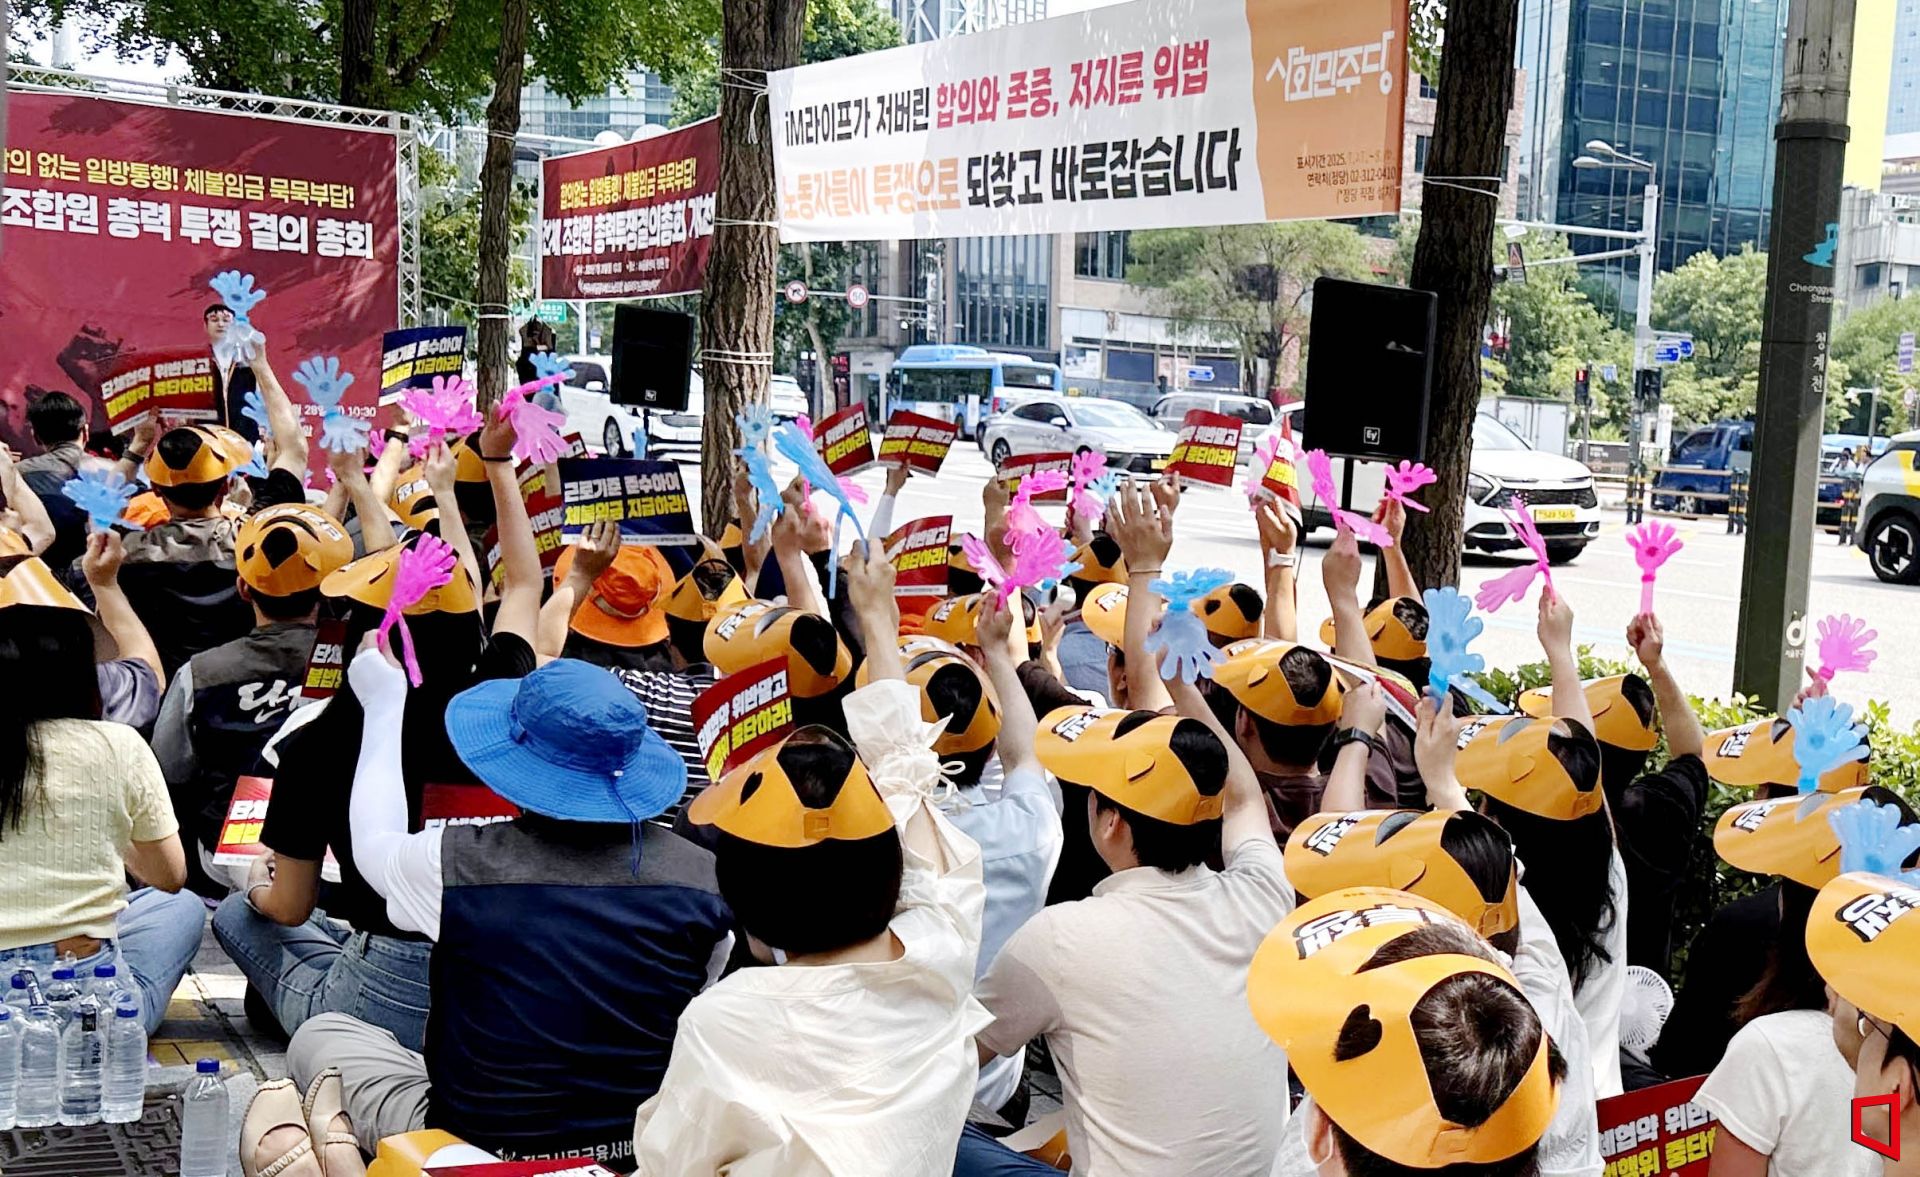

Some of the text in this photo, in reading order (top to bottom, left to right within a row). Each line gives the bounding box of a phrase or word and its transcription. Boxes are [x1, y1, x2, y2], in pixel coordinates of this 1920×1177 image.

[784, 39, 1210, 147] iM라이프가 저버린 합의와 존중, 저지른 위법
[37, 151, 81, 182] 없는
[85, 158, 179, 190] 일방통행!
[184, 168, 264, 200] 체불임금
[269, 178, 355, 209] 묵묵부답!
[783, 127, 1241, 220] 노동자들이 투쟁으로 되찾고 바로잡습니다
[2, 186, 374, 259] 조합원 총력 투쟁 결의 총회
[562, 215, 593, 255] 조합원
[1811, 331, 1827, 393] 청계천
[348, 406, 377, 418] 10:30
[731, 698, 793, 751] 중단하라!
